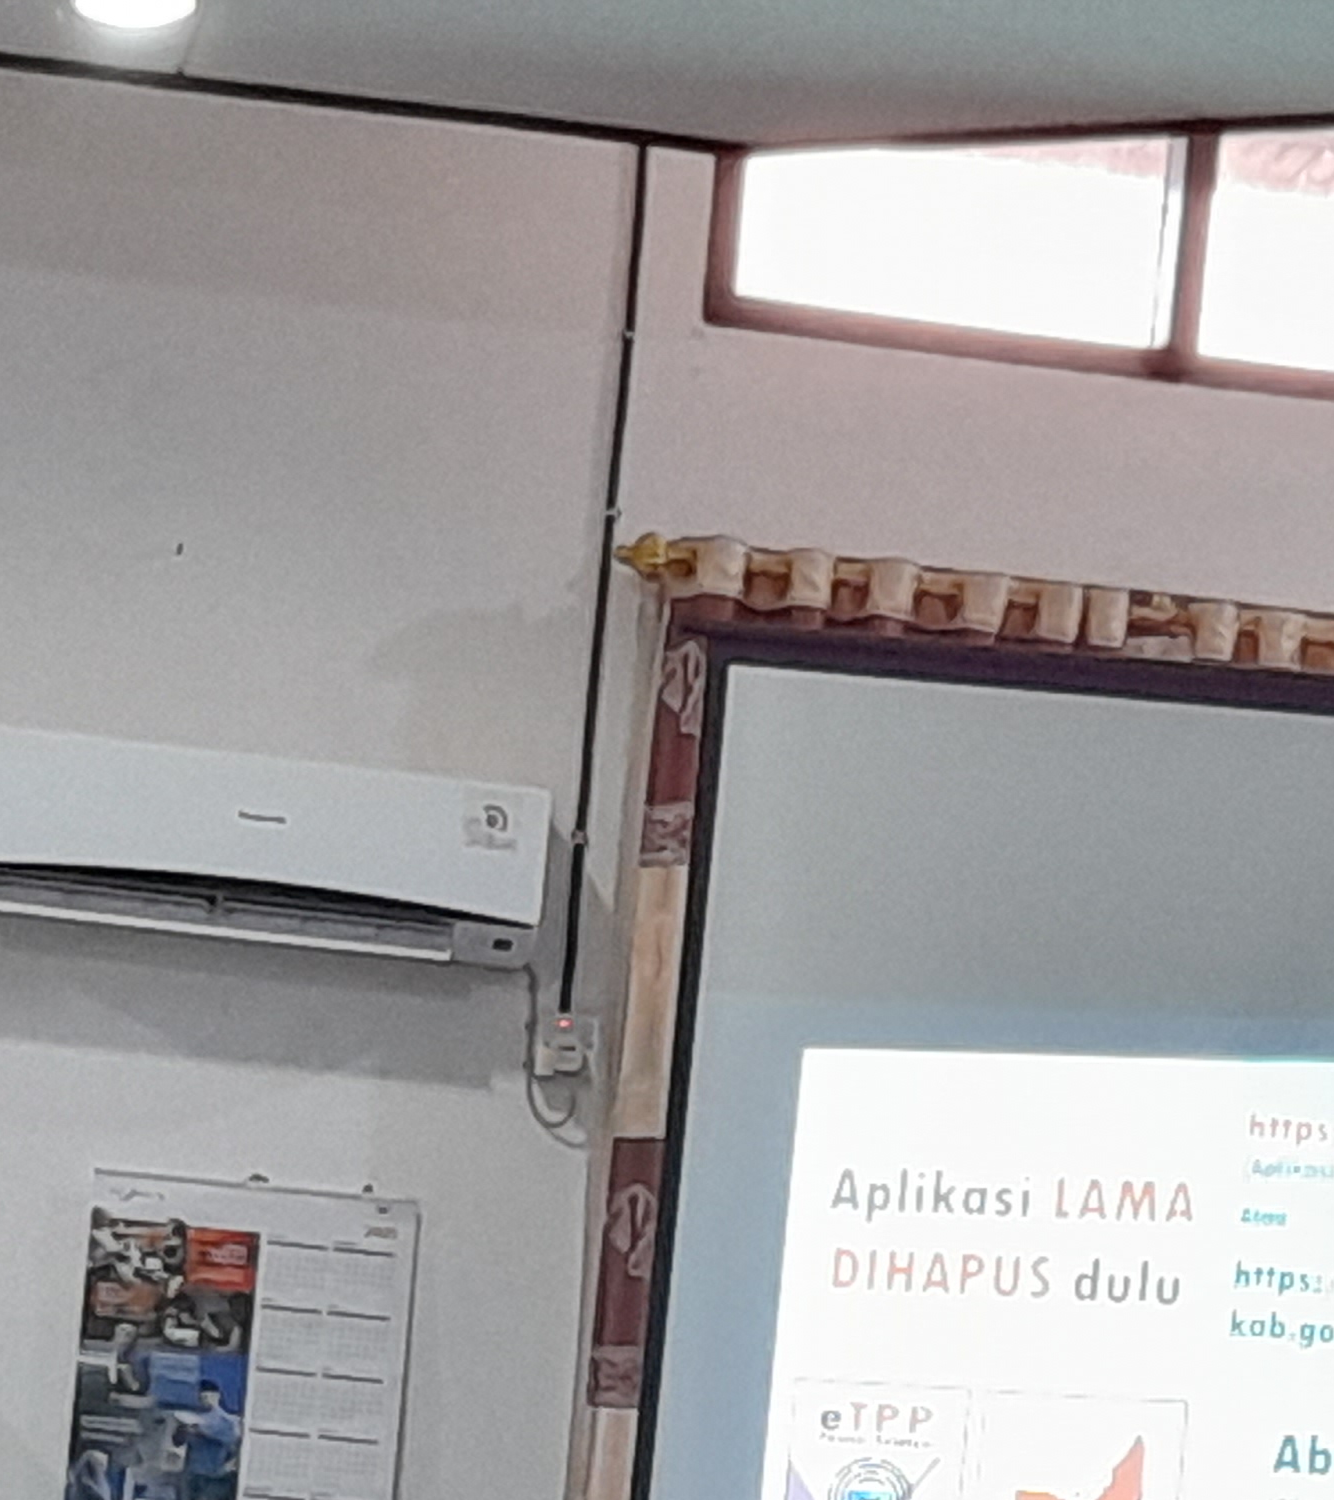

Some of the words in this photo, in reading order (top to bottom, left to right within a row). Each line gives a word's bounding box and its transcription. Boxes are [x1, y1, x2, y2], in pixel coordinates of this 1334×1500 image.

[830, 1167, 1031, 1223] Aplikasi
[1054, 1177, 1193, 1222] LAMA
[832, 1247, 1050, 1299] DIHAPUS
[1074, 1258, 1181, 1305] dulu
[820, 1401, 933, 1434] eTPP
